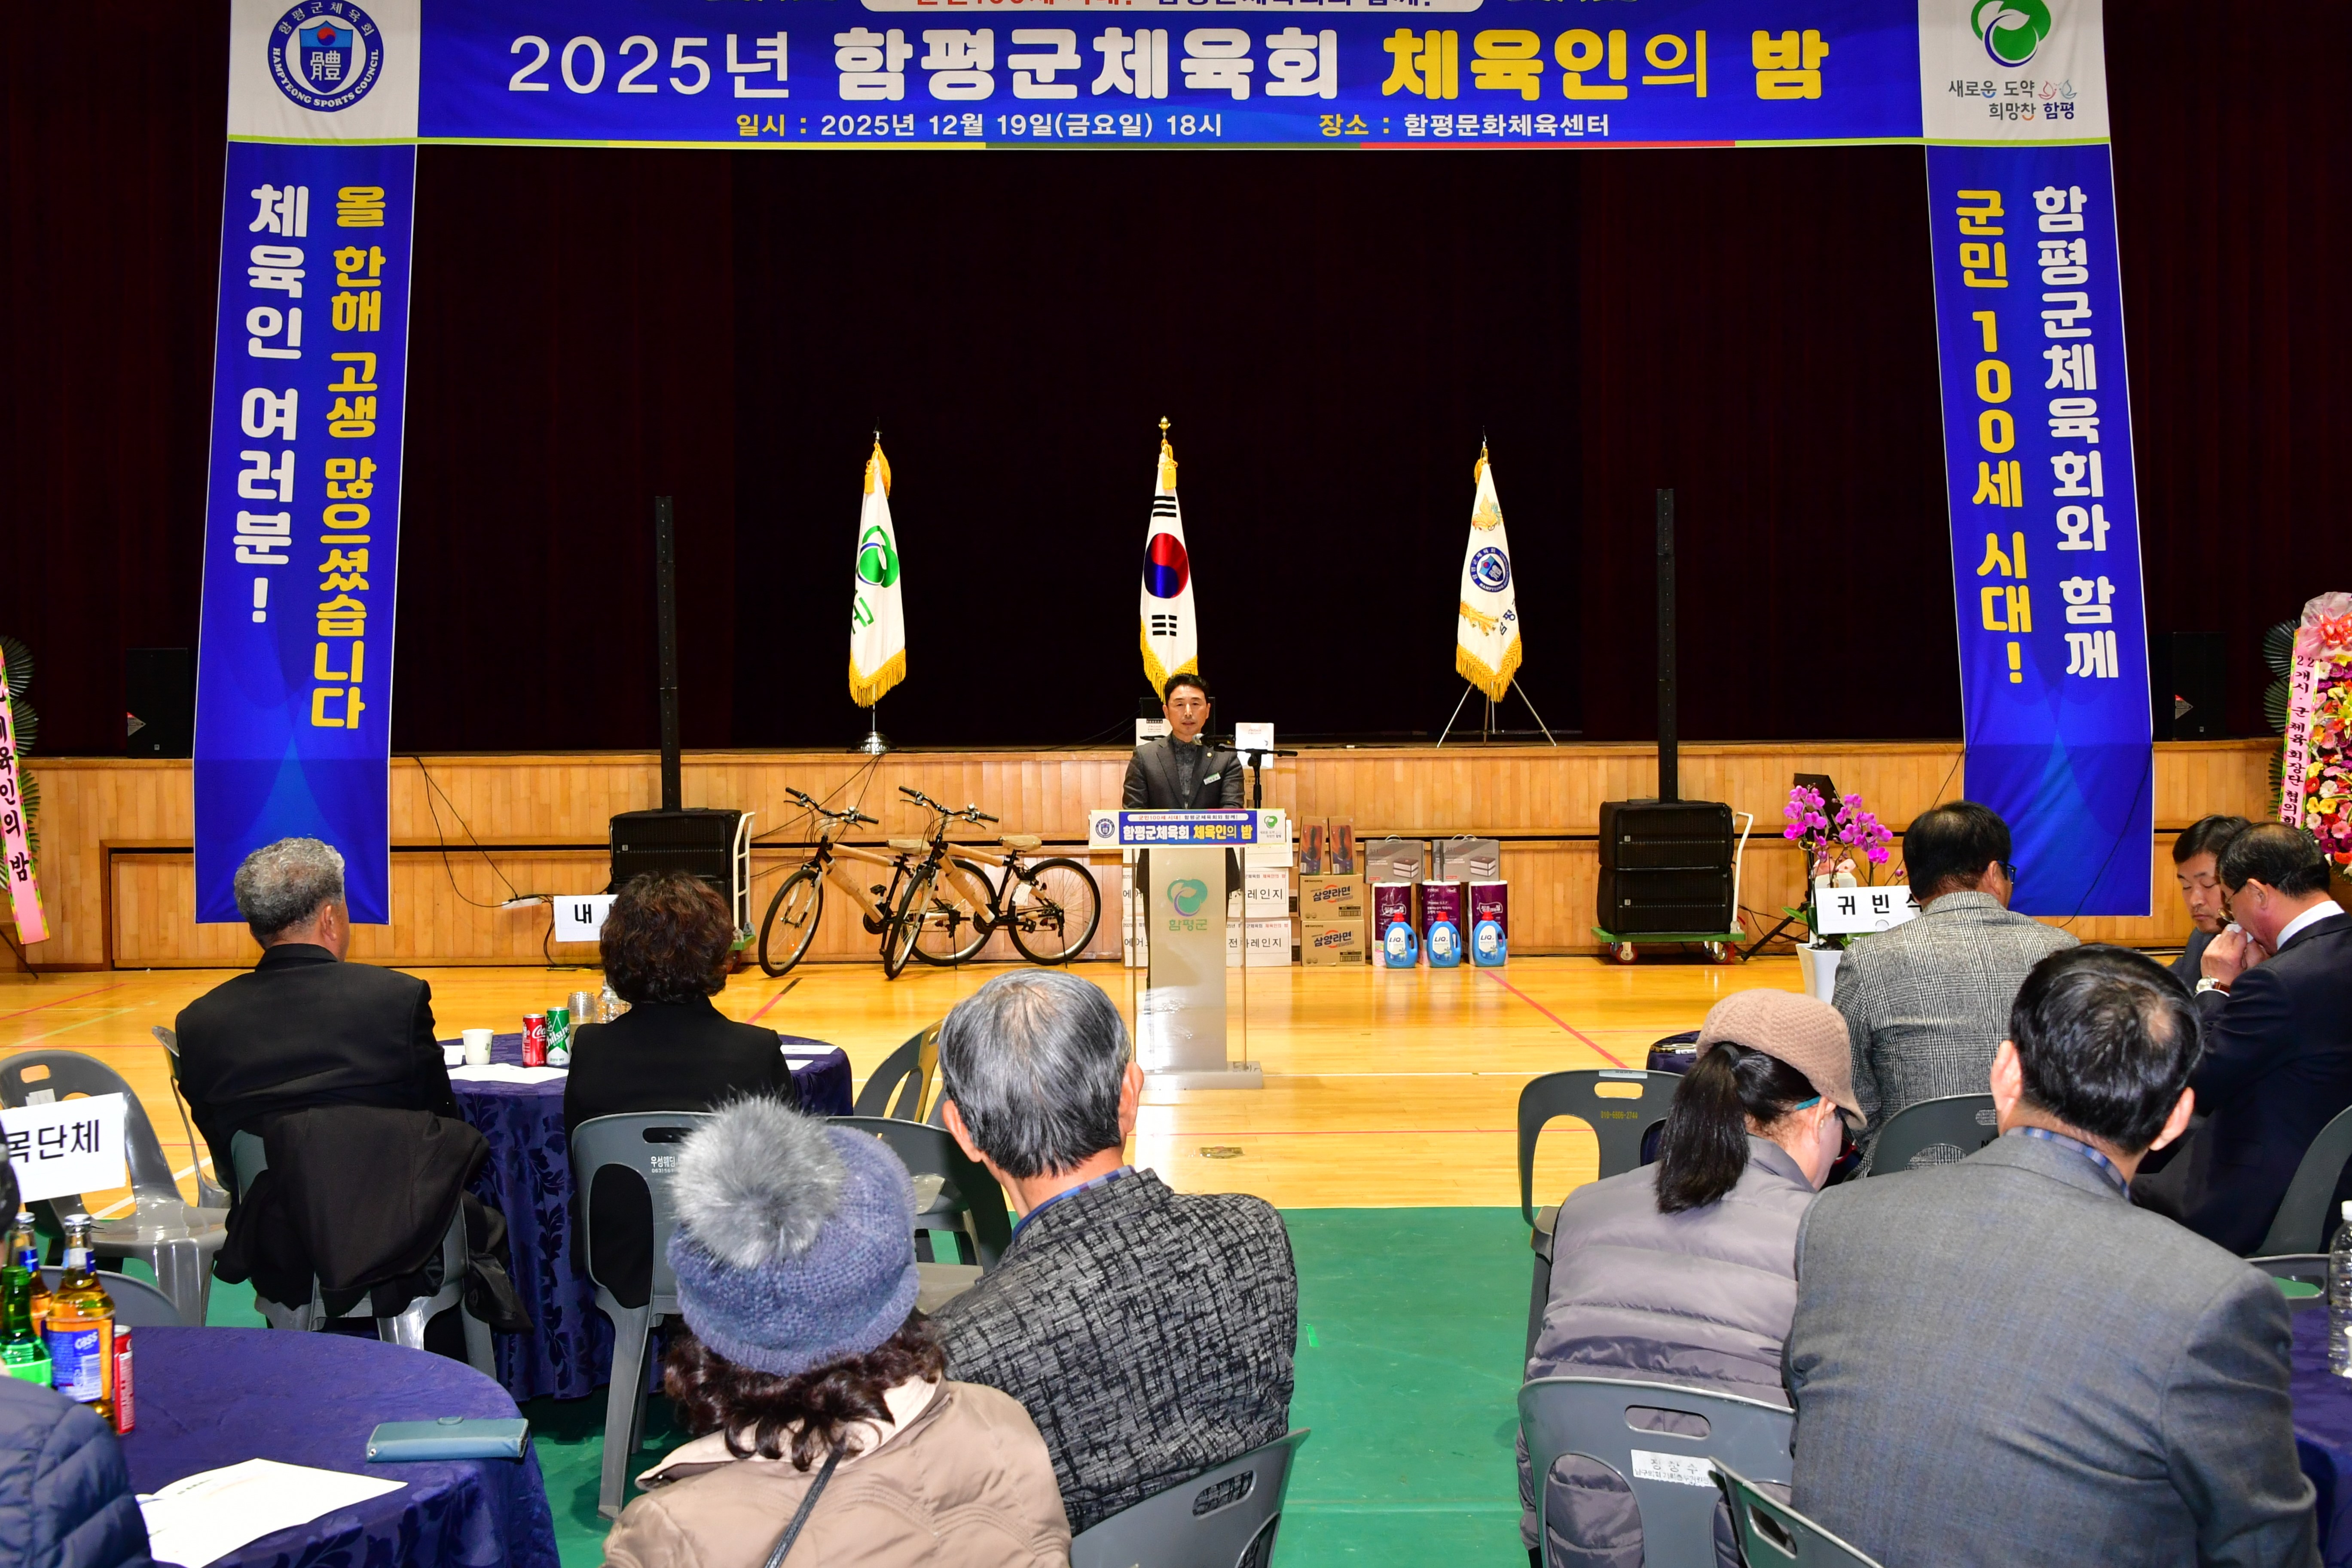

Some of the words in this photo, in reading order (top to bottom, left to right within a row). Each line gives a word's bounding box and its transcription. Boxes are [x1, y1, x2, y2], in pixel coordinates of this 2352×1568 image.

[279, 2, 375, 36] 함평군체육회
[273, 47, 312, 104] HAMPYEONG
[313, 92, 355, 107] SPORTS
[355, 49, 379, 94] COUNCIL
[509, 31, 789, 98] 2025년
[833, 27, 1338, 101] 함평군체육회
[1382, 28, 1707, 101] 체육인의
[1752, 29, 1830, 100] 밤
[1949, 80, 1997, 98] 새로운
[2004, 80, 2035, 98] 도약
[736, 113, 785, 136] 일시
[821, 114, 914, 136] 2025년
[929, 114, 984, 136] 12월
[997, 113, 1153, 138] 19일(금요일)
[1167, 114, 1222, 137] 18시
[1318, 113, 1369, 135] 장소
[1404, 113, 1609, 137] 함평문화체육센터
[1989, 102, 2036, 121] 희망찬
[2043, 102, 2074, 120] 함평
[336, 186, 386, 227] 올
[1956, 190, 2009, 288] 군민
[245, 184, 309, 360] 체육인
[331, 245, 386, 332] 한해
[2032, 186, 2111, 551] 함평군체육회와
[326, 352, 378, 438] 고생
[1972, 310, 2023, 507] 100세
[233, 388, 298, 623] 여러분!
[311, 457, 377, 729] 많으셨습니다
[1976, 531, 2032, 684] 시대!
[2059, 575, 2119, 678] 함께
[1123, 825, 1189, 840] 함평군체육회
[1193, 825, 1237, 840] 체육인의
[1240, 825, 1253, 840] 밤
[9, 851, 29, 883] 밤
[1313, 886, 1350, 902] 삼양라면
[1169, 919, 1208, 931] 함평군
[1314, 931, 1352, 948] 삼양라면
[651, 1156, 675, 1168] 우성웨딩
[74, 1331, 98, 1349] Cass
